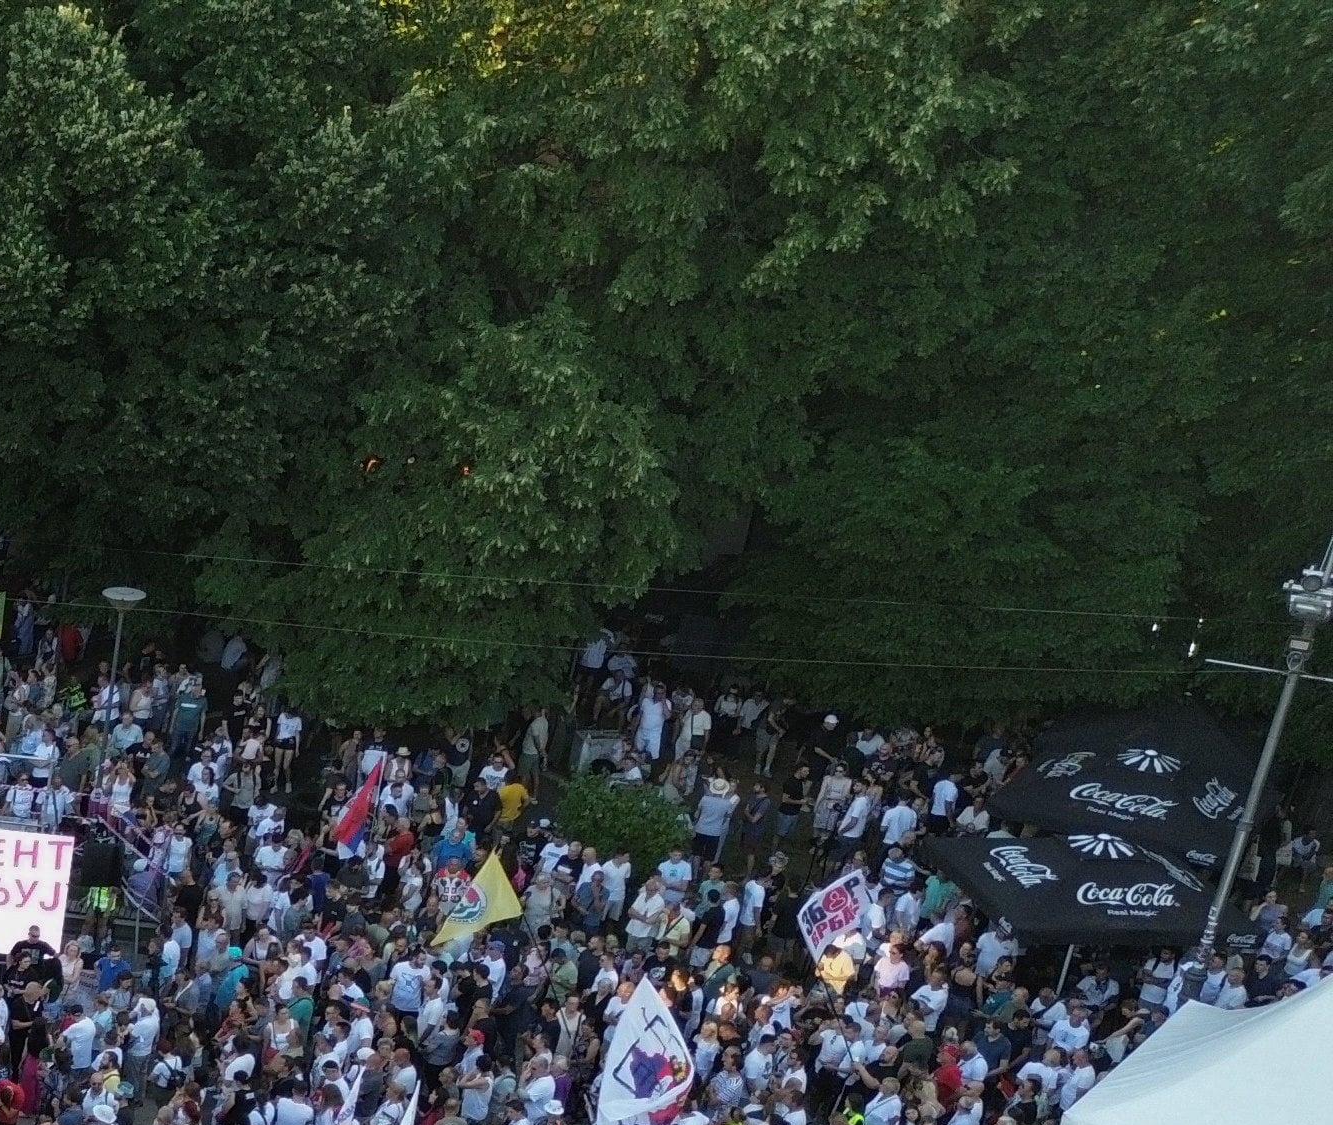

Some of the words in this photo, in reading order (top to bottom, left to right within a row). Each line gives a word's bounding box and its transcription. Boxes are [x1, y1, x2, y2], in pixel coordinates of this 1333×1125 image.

[1069, 782, 1180, 819] Coca-Cola
[1076, 881, 1180, 908] Coca-Cola
[1106, 908, 1129, 917] Real
